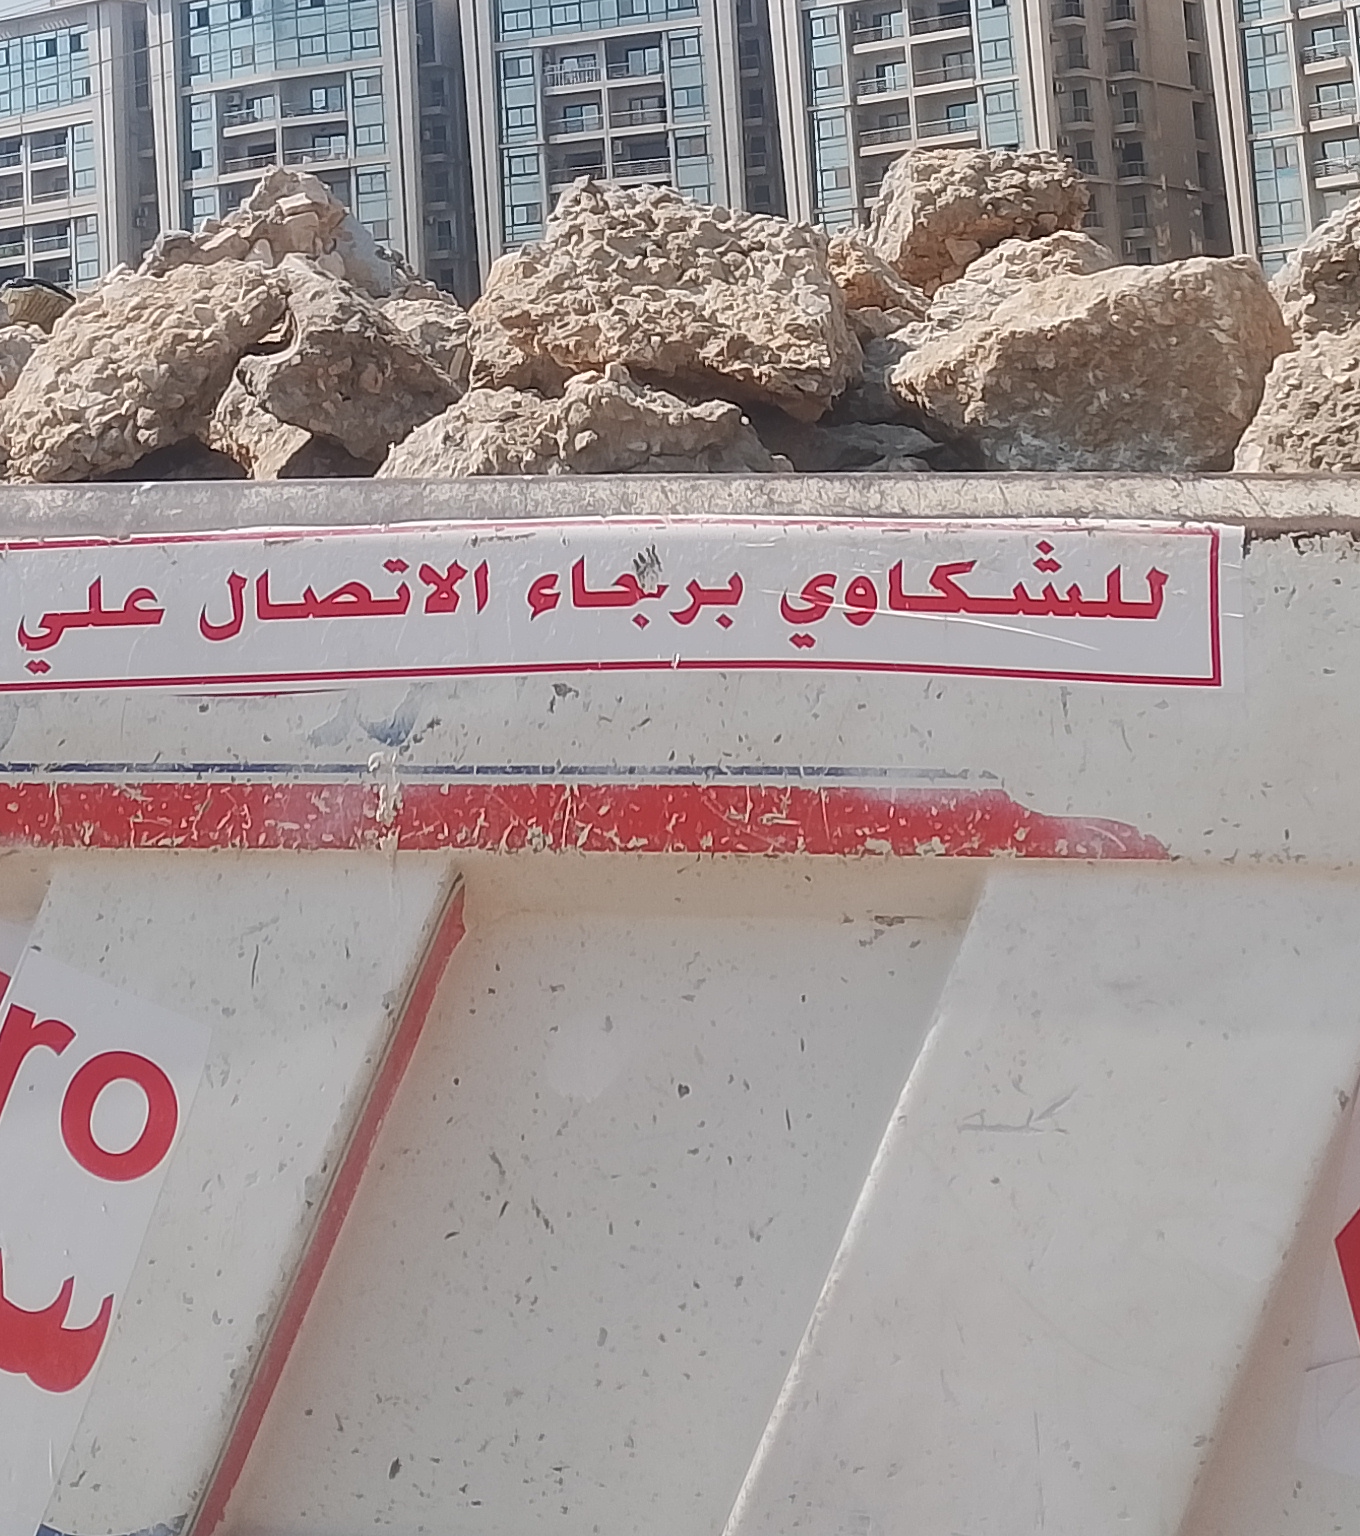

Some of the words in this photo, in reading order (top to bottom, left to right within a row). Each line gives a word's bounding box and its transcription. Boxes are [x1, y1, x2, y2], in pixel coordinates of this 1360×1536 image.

[198, 558, 489, 642] الاتصال
[526, 555, 744, 629] برجاء
[779, 540, 1170, 649] للشكاوي
